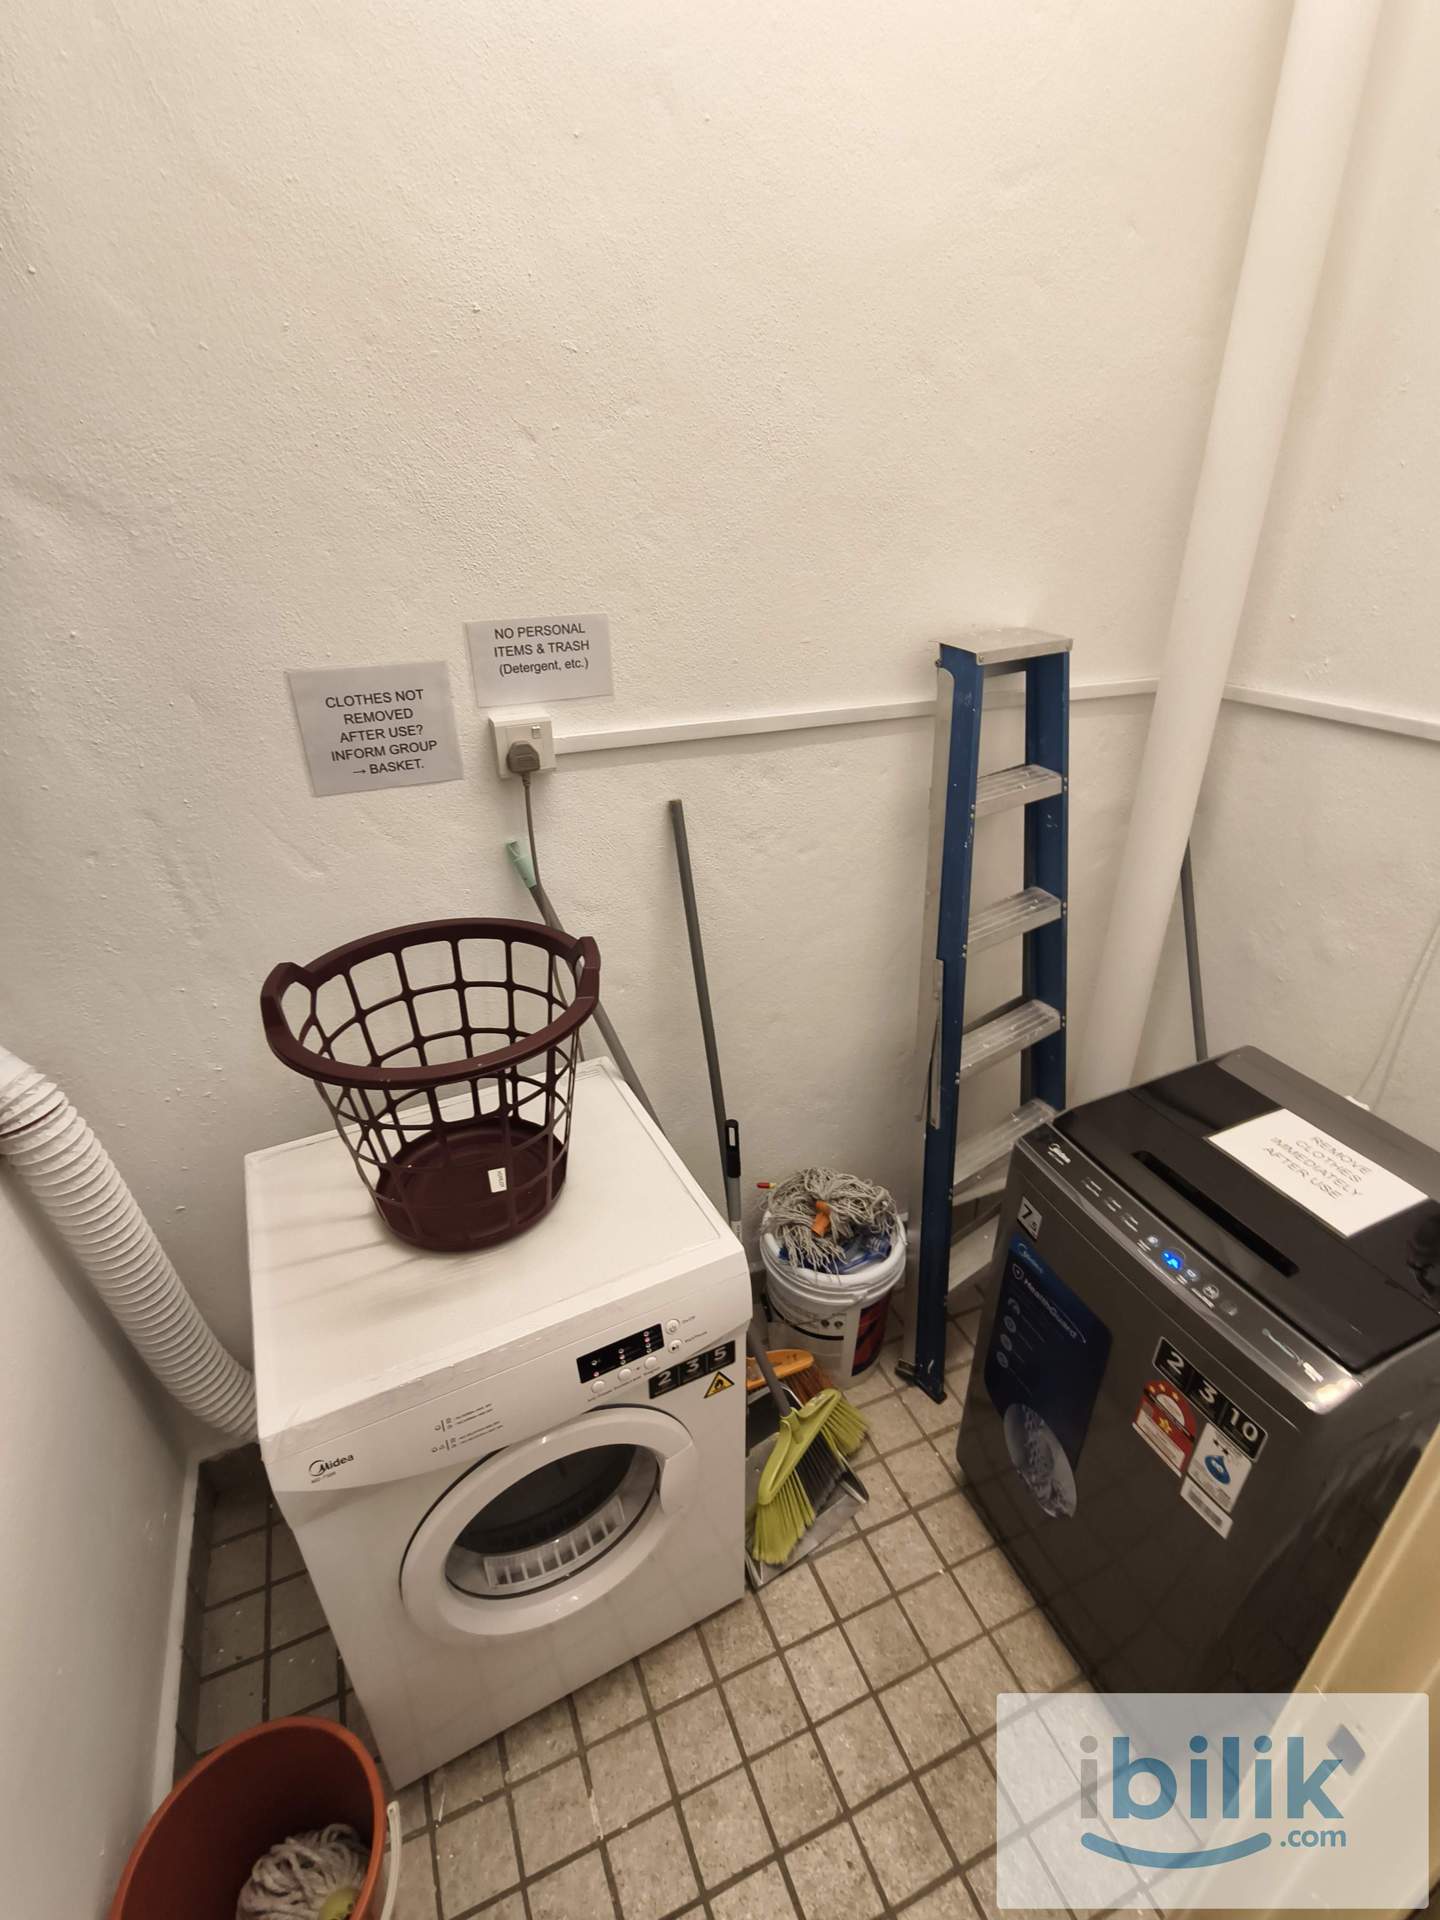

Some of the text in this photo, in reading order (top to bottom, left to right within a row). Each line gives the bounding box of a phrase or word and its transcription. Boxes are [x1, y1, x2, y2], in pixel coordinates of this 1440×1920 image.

[494, 622, 586, 640] NO PERSONAL
[494, 640, 590, 658] ITEMS & TRASH
[499, 657, 589, 677] (Detergent, etc.)
[325, 689, 424, 709] CLOTHES NOT
[343, 708, 414, 725] REMOVED
[339, 724, 424, 744] AFTER USE?
[331, 740, 438, 762] INFORM GROUP
[369, 759, 425, 775] BASKET.
[1269, 1136, 1363, 1196] IMMEDIATELY
[1295, 1139, 1362, 1183] CLOTHES
[1312, 1136, 1372, 1174] REMOVE
[1263, 1147, 1342, 1200] AFTER USE
[656, 1370, 672, 1386] 2
[686, 1357, 699, 1373] 3
[713, 1346, 727, 1361] 5
[1167, 1351, 1259, 1442] 2 3 10
[308, 1454, 354, 1477] Midea
